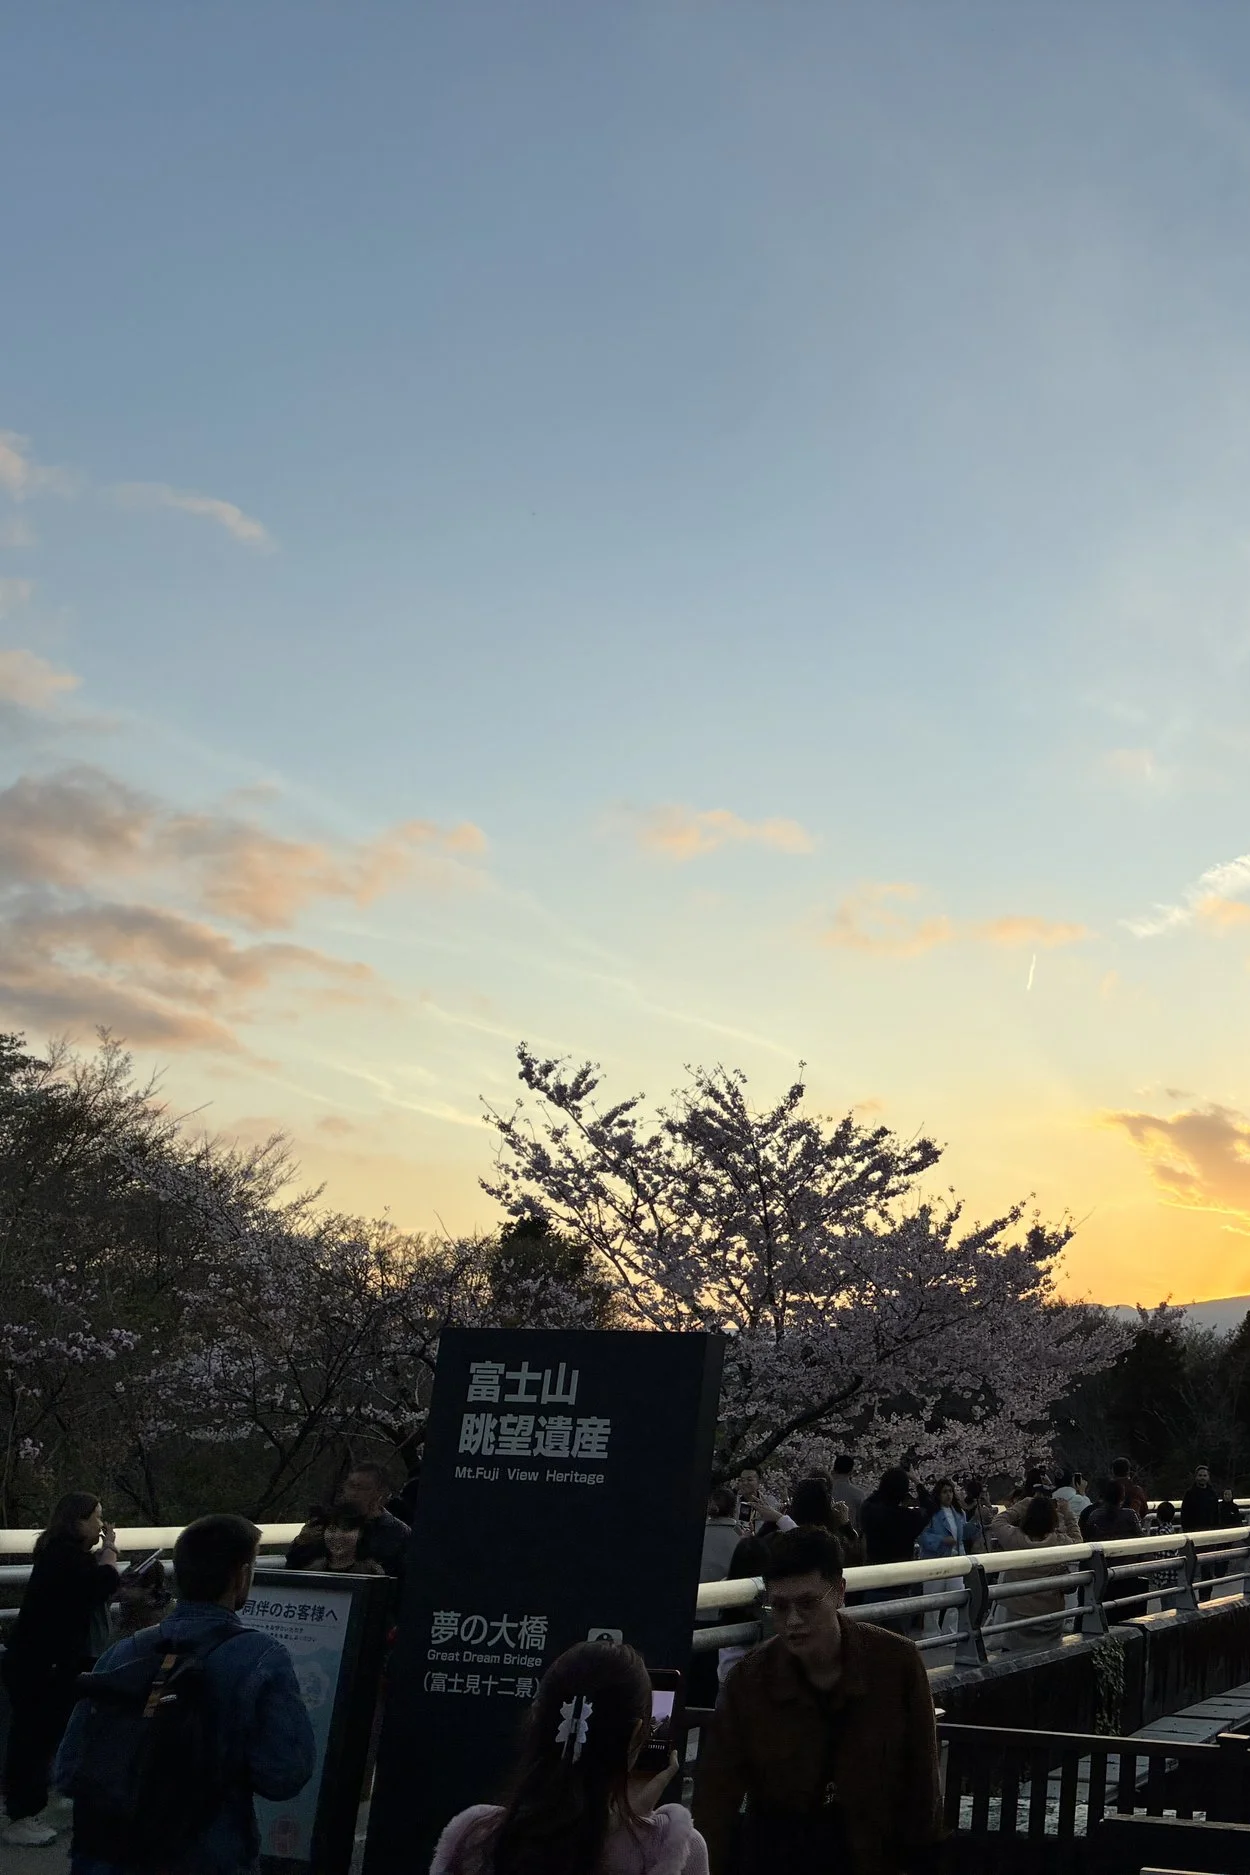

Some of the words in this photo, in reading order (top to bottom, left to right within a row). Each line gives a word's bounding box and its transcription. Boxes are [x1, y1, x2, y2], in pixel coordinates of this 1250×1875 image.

[466, 1360, 579, 1405] 富士山
[458, 1412, 611, 1459] 眺望遺産
[454, 1466, 500, 1482] Mt.Fuji
[507, 1467, 539, 1482] View
[545, 1469, 605, 1485] Heritage
[430, 1610, 549, 1651] 夢の大橋
[427, 1648, 460, 1662] Great
[463, 1650, 500, 1664] Dream
[503, 1653, 543, 1668] Bridge
